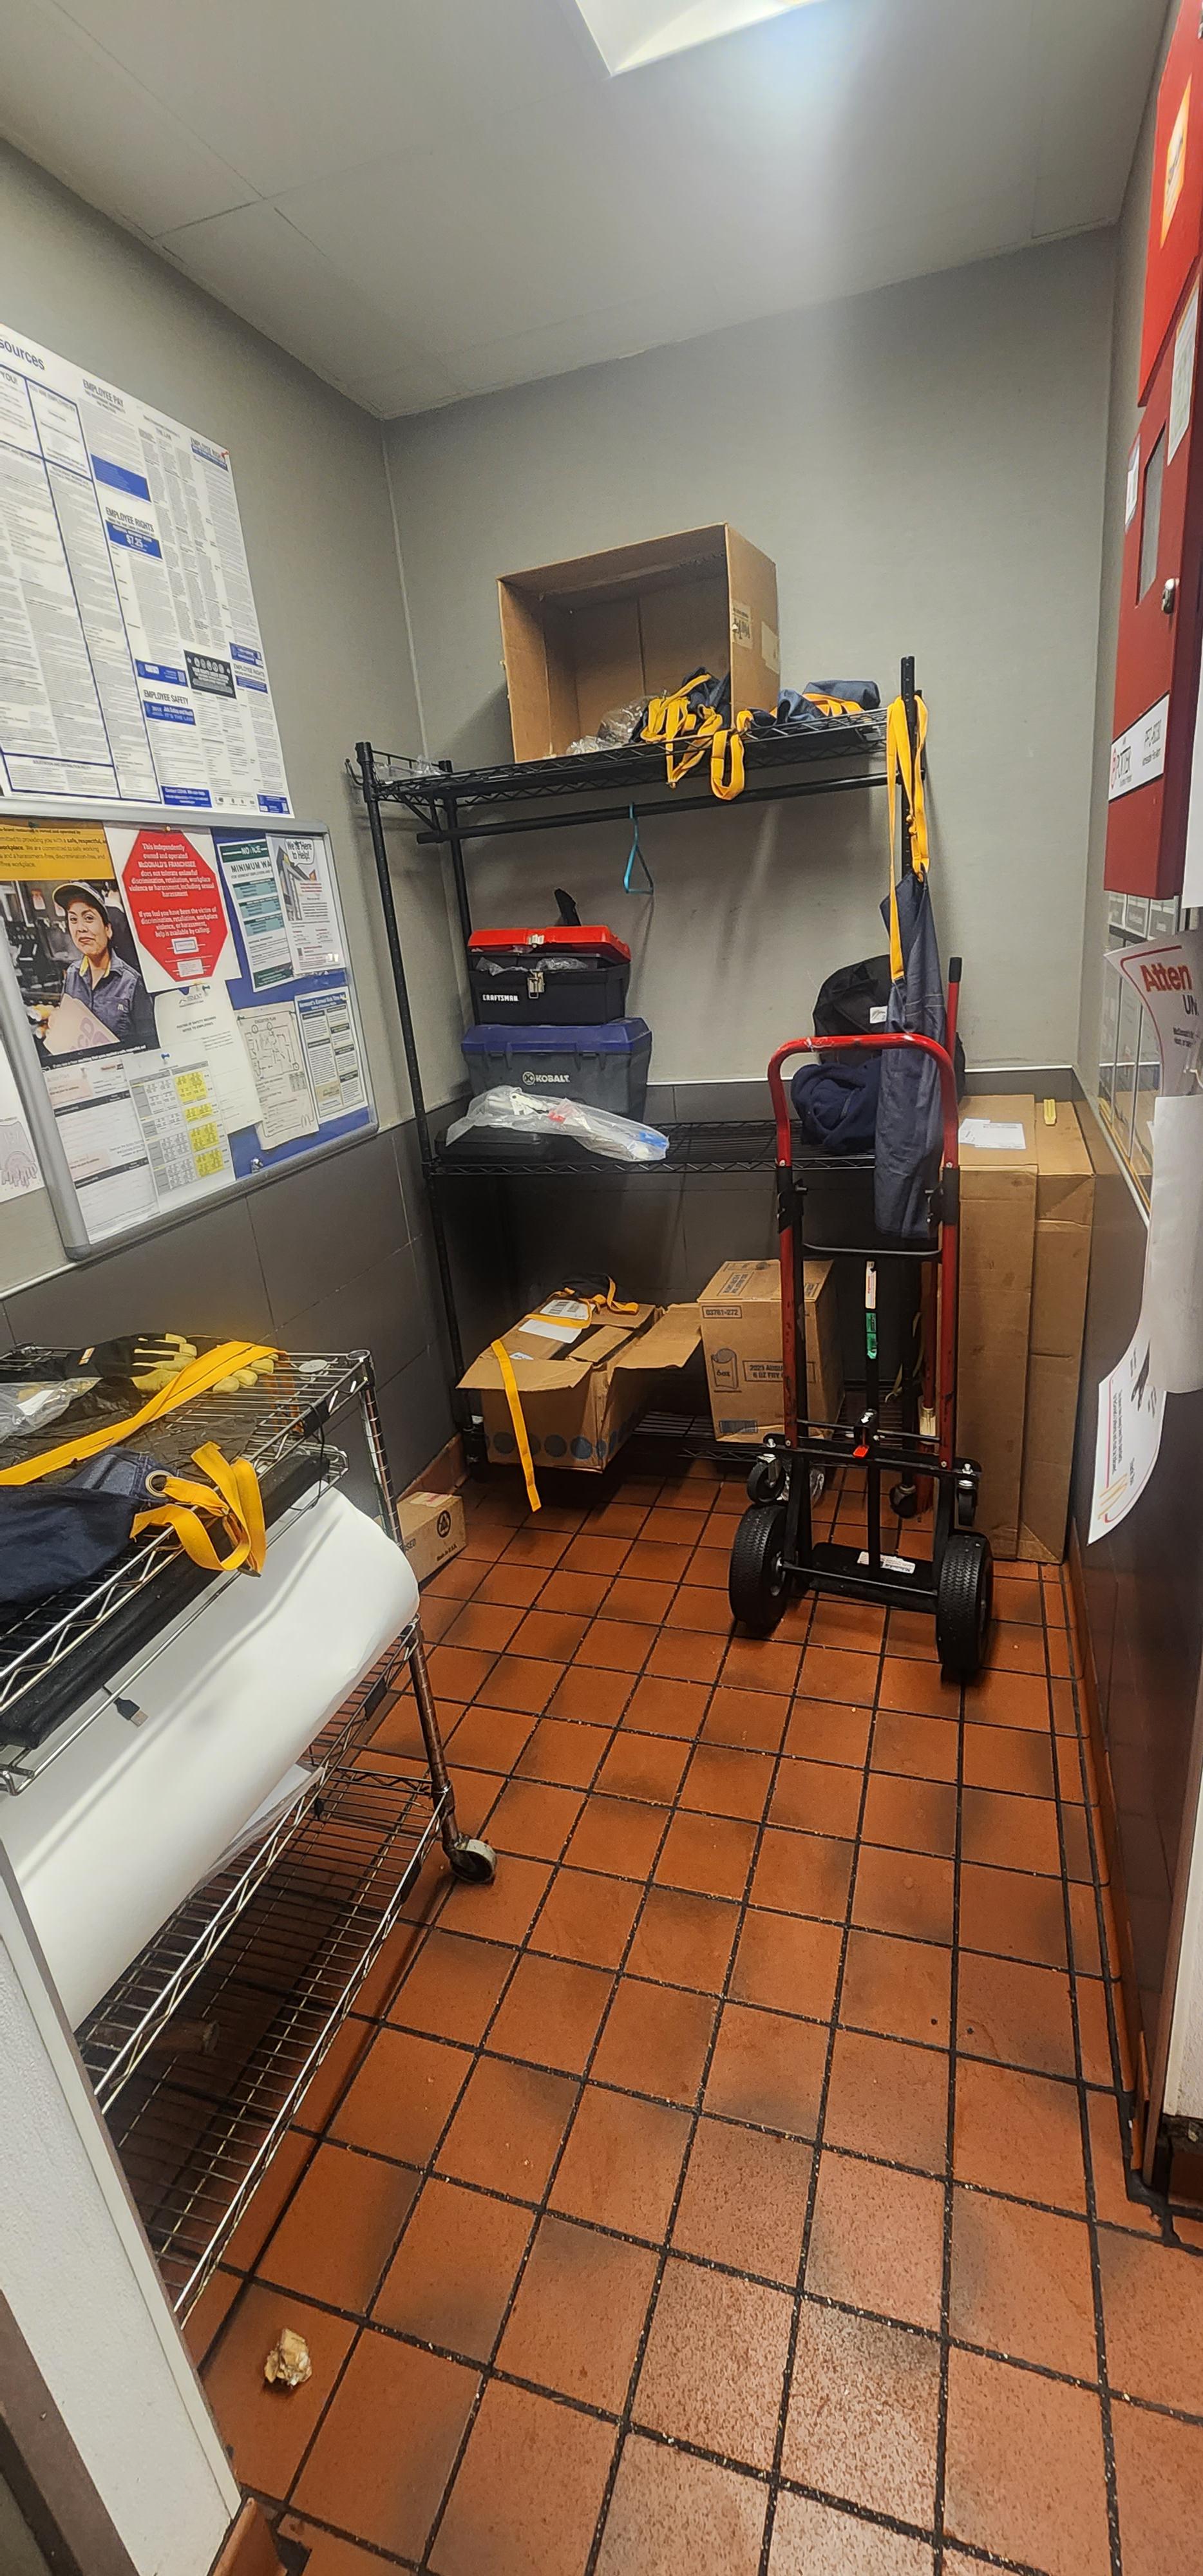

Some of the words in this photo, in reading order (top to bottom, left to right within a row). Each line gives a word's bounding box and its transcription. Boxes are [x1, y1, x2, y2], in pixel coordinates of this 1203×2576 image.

[82, 379, 112, 402] EMPLOYEE
[113, 394, 124, 408] PAY
[105, 506, 135, 526] EMPLOYEE
[135, 519, 154, 533] RIGHTS
[143, 689, 171, 702] EMPLOYEE
[171, 694, 189, 705] SAFETY
[287, 838, 301, 851] Were
[301, 839, 313, 850] Here
[292, 851, 298, 860] to
[298, 850, 310, 862] Help!
[231, 861, 259, 873] MINIMUM
[1139, 962, 1193, 992] Atten
[482, 994, 519, 1002] CRAFTSMAN
[535, 1074, 570, 1083] KOBALT
